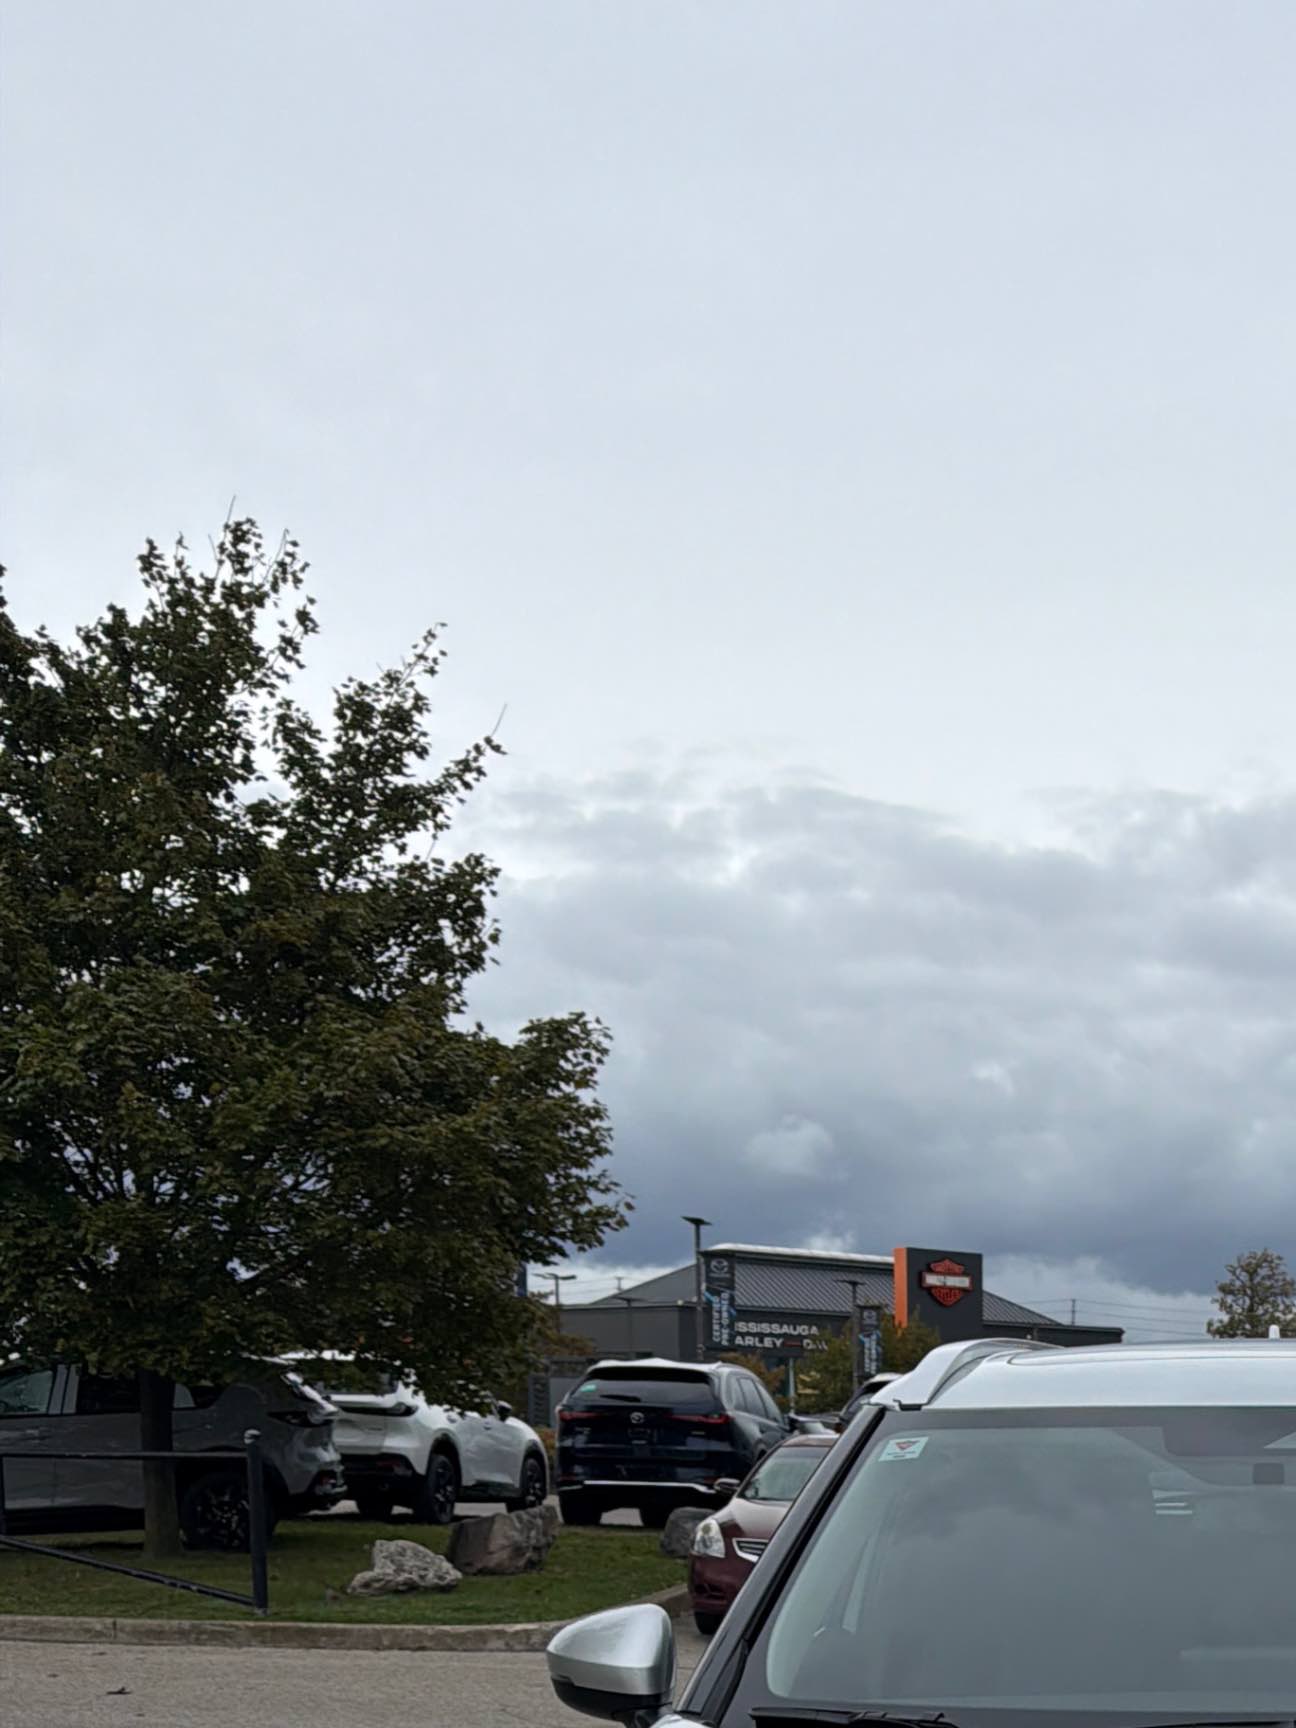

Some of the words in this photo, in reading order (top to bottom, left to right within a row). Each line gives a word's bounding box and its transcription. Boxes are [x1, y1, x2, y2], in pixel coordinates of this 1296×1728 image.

[712, 1296, 720, 1342] CERTIFIED
[721, 1293, 729, 1346] PRE-OWNED
[735, 1321, 819, 1335] ISSISSAUGA
[734, 1335, 784, 1348] ARLEY
